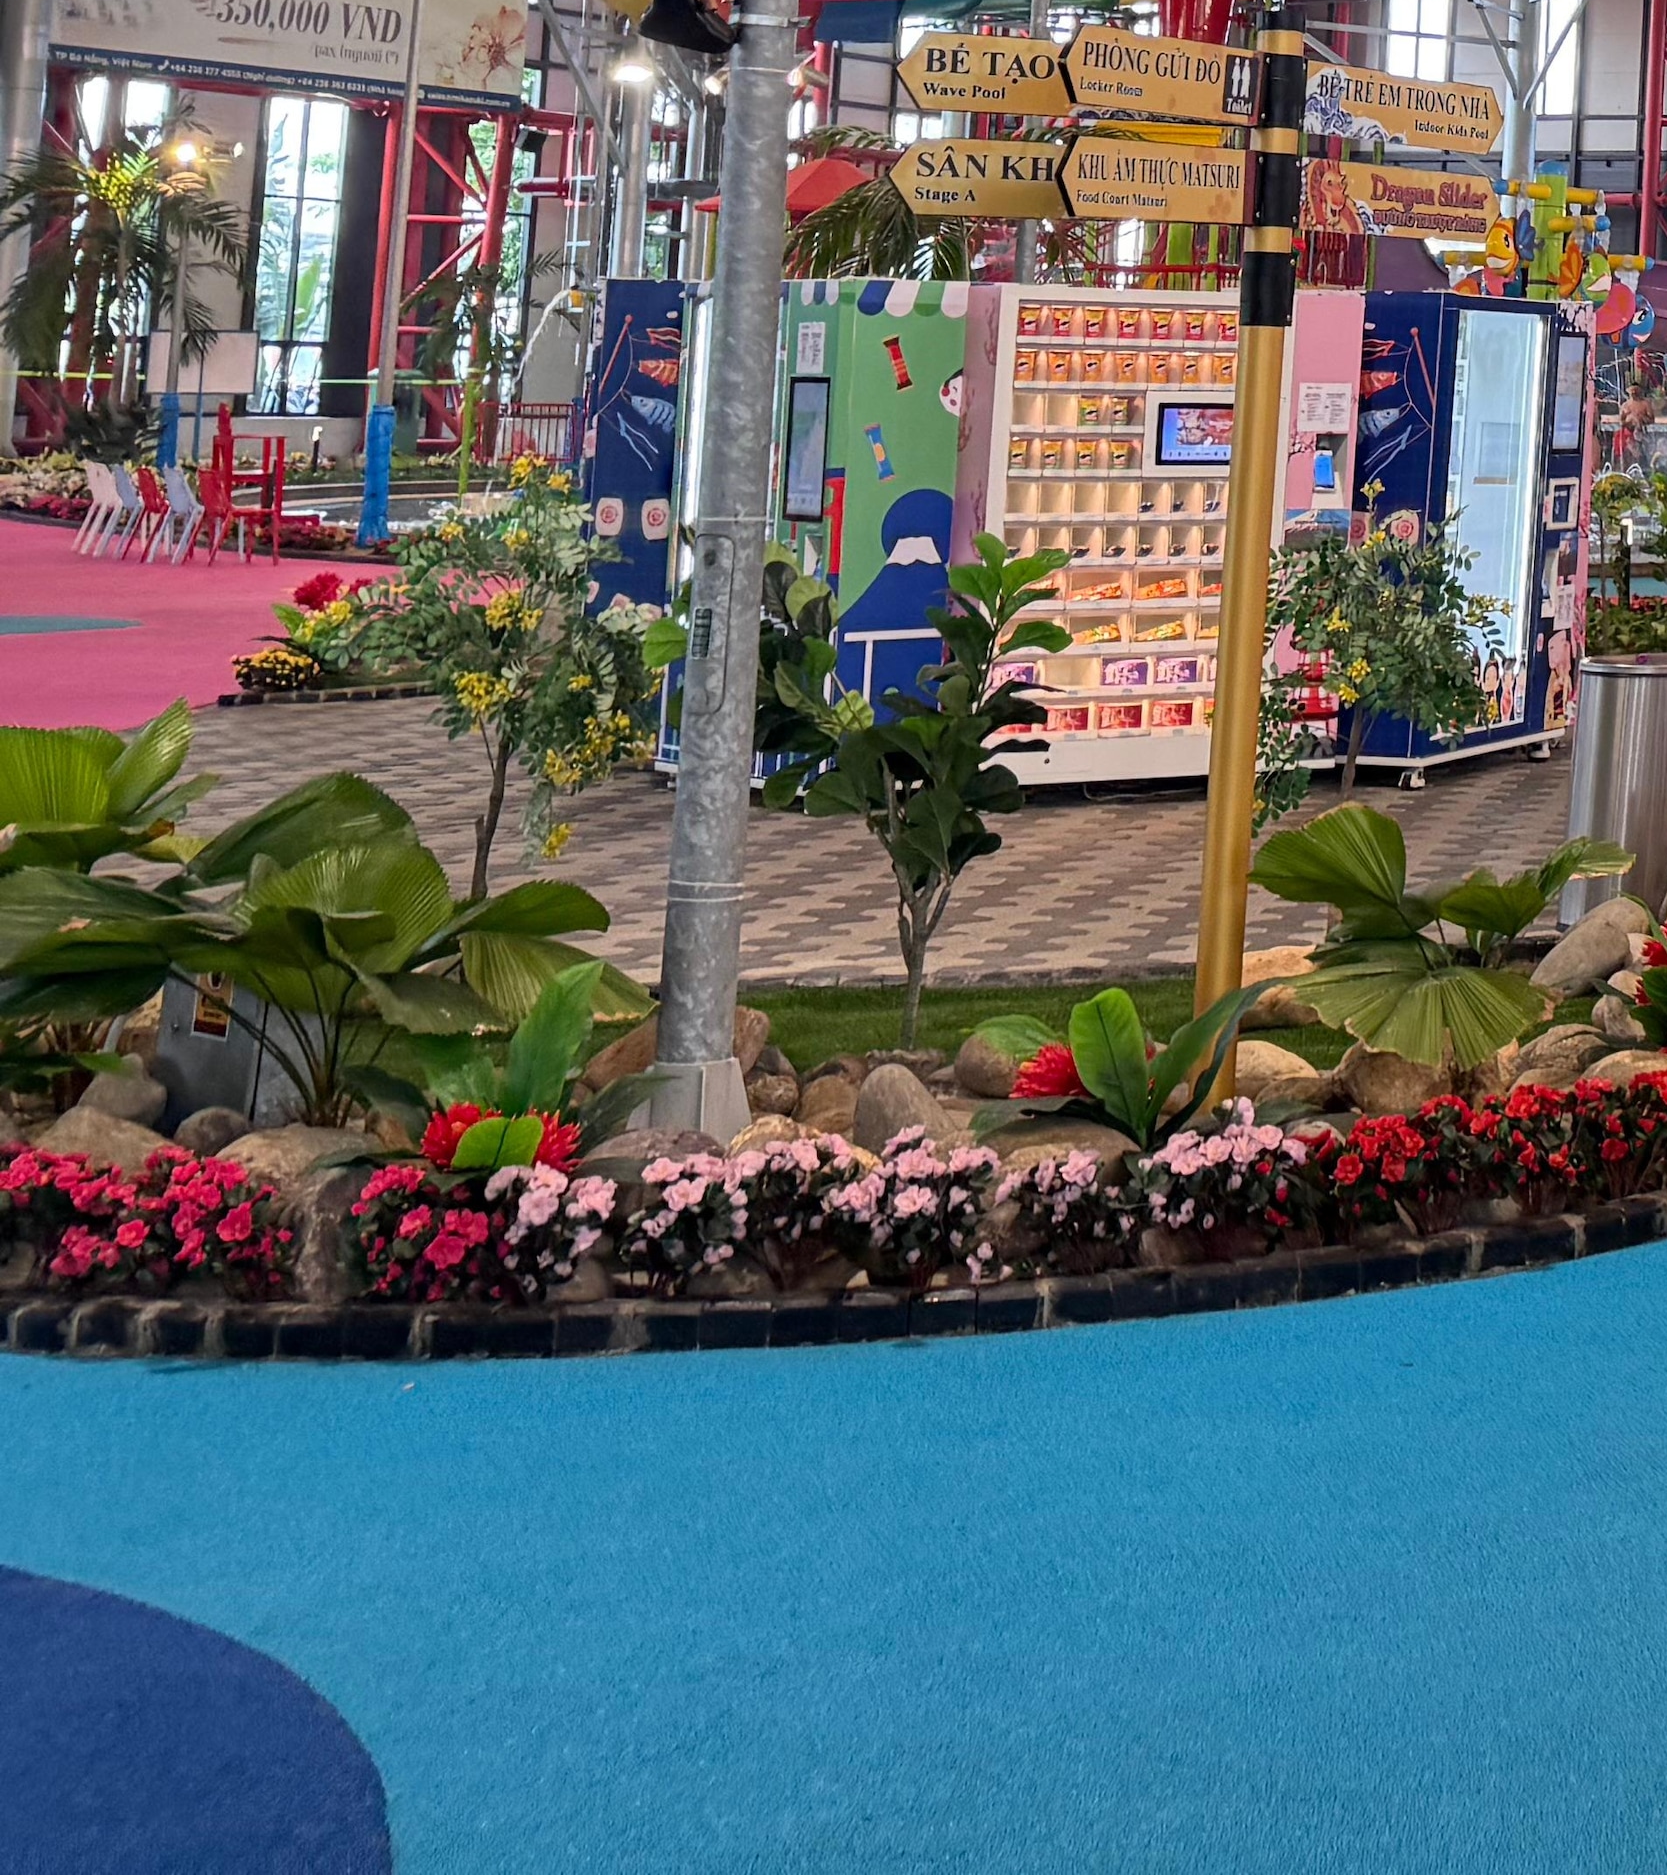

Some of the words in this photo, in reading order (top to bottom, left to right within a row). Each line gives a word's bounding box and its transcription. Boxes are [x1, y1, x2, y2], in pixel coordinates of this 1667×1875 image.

[342, 2, 402, 43] VND
[982, 51, 1055, 84] TẠO
[1083, 37, 1150, 75] PHÒNG
[923, 82, 966, 97] Wave
[972, 85, 1005, 99] Pool
[1080, 76, 1114, 94] Locker
[1116, 82, 1143, 97] Room
[1378, 83, 1401, 107] EM
[1406, 87, 1456, 116] TRONG
[1459, 92, 1489, 121] NHÀ
[1414, 119, 1445, 135] Indoor
[1447, 123, 1467, 137] Kids
[1470, 128, 1489, 140] Pool
[916, 145, 988, 179] SÂN
[1078, 153, 1109, 181] KHU
[1139, 156, 1178, 191] THỰC
[1181, 162, 1241, 189] MATSURI
[914, 186, 959, 203] Stage
[964, 189, 976, 202] A
[1076, 189, 1099, 204] Food
[1102, 191, 1129, 205] Court
[1132, 194, 1168, 207] Matsuri
[1371, 173, 1435, 211] Dragon
